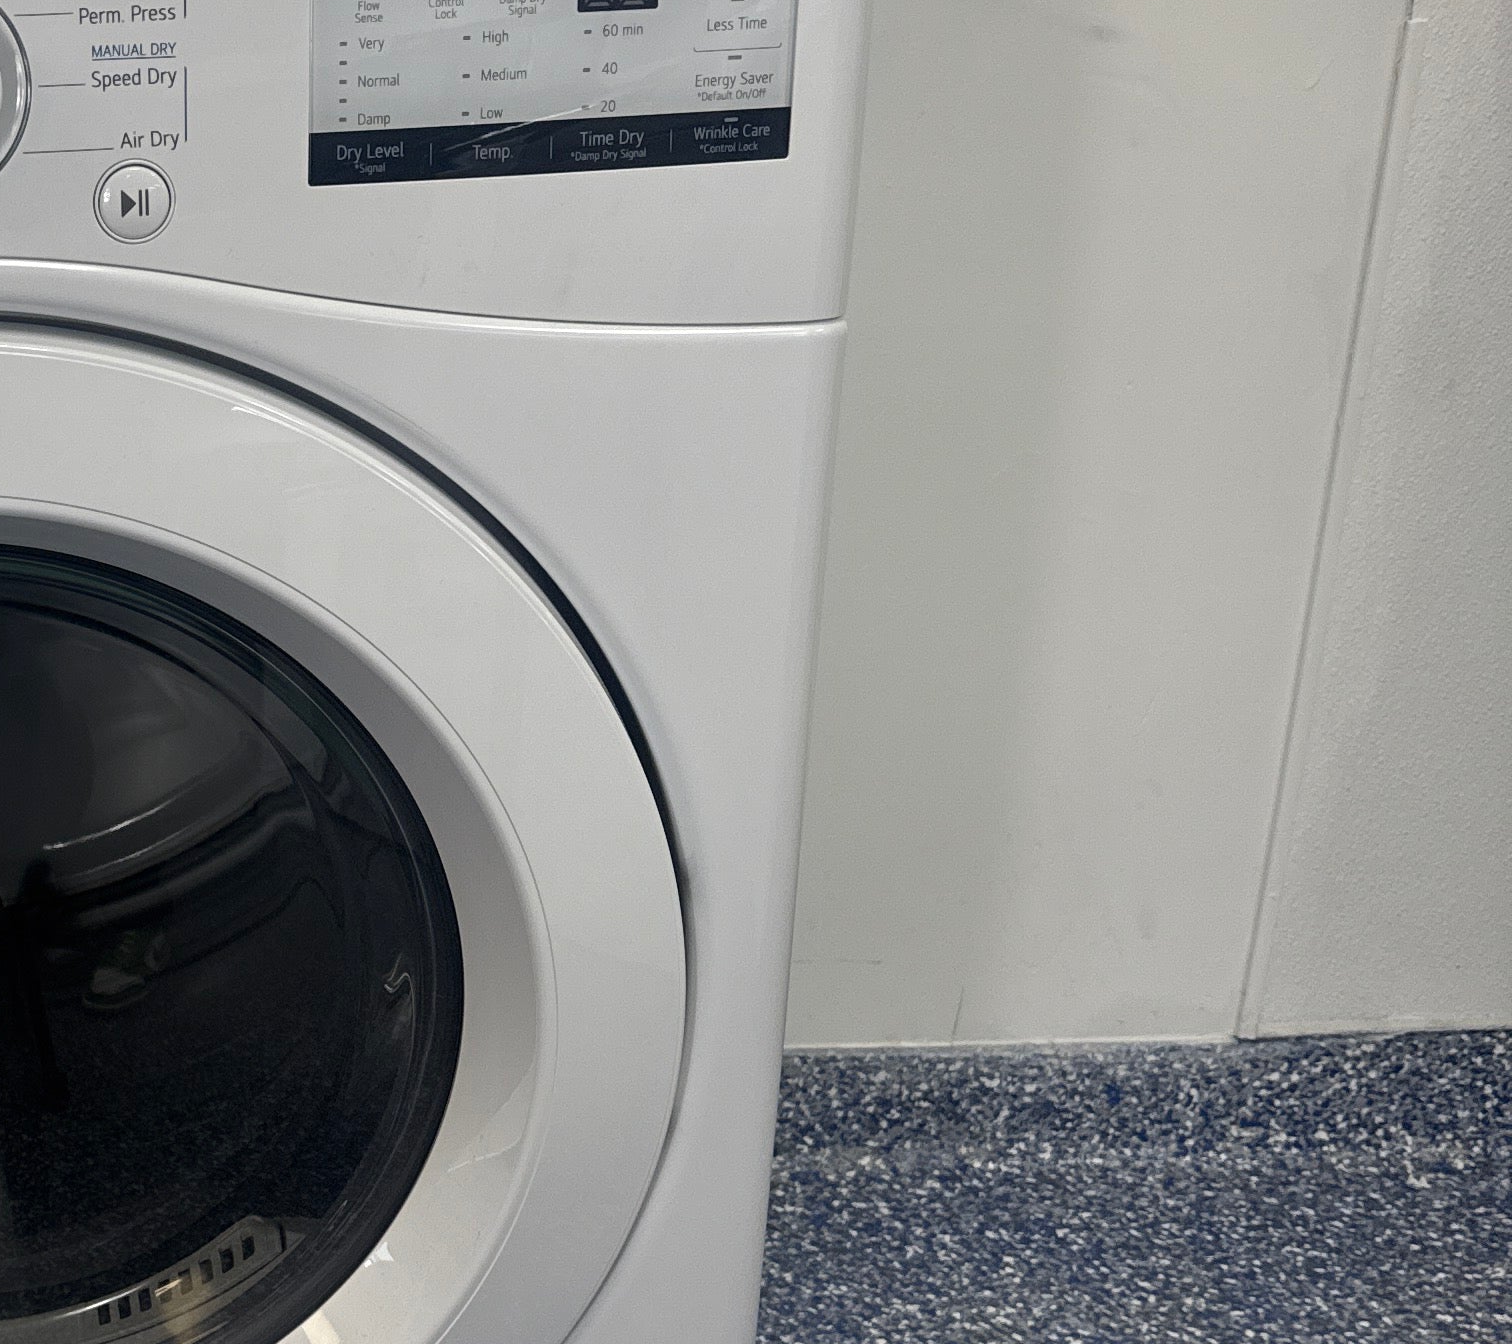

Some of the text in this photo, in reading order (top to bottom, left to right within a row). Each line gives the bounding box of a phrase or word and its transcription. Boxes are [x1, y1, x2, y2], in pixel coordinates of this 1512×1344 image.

[357, 1, 381, 11] Flow
[508, 5, 537, 18] Signal
[78, 4, 176, 25] Perm. Press
[354, 12, 384, 23] Sense
[435, 8, 458, 20] Lock
[602, 23, 644, 38] 60 min
[706, 16, 768, 32] Less Time
[358, 37, 385, 52] Very
[482, 30, 510, 46] High
[91, 41, 177, 58] MANUAL DRY
[480, 67, 528, 82] Medium
[601, 61, 618, 75] 40
[91, 67, 178, 93] Speed Dry
[357, 72, 401, 88] Normal
[695, 71, 775, 90] Energy Saver
[735, 87, 767, 100] On/Off
[480, 107, 504, 120] Low
[600, 99, 617, 113] 20
[357, 112, 391, 128] Damp
[579, 129, 645, 148] Time Dry
[693, 123, 771, 141] Wrinkle Care
[120, 130, 180, 151] Air Dry
[738, 140, 759, 152] Lock
[336, 141, 405, 163] Dry Level
[471, 144, 514, 162] Temp.
[602, 150, 618, 161] Dry
[620, 147, 647, 161] Signal
